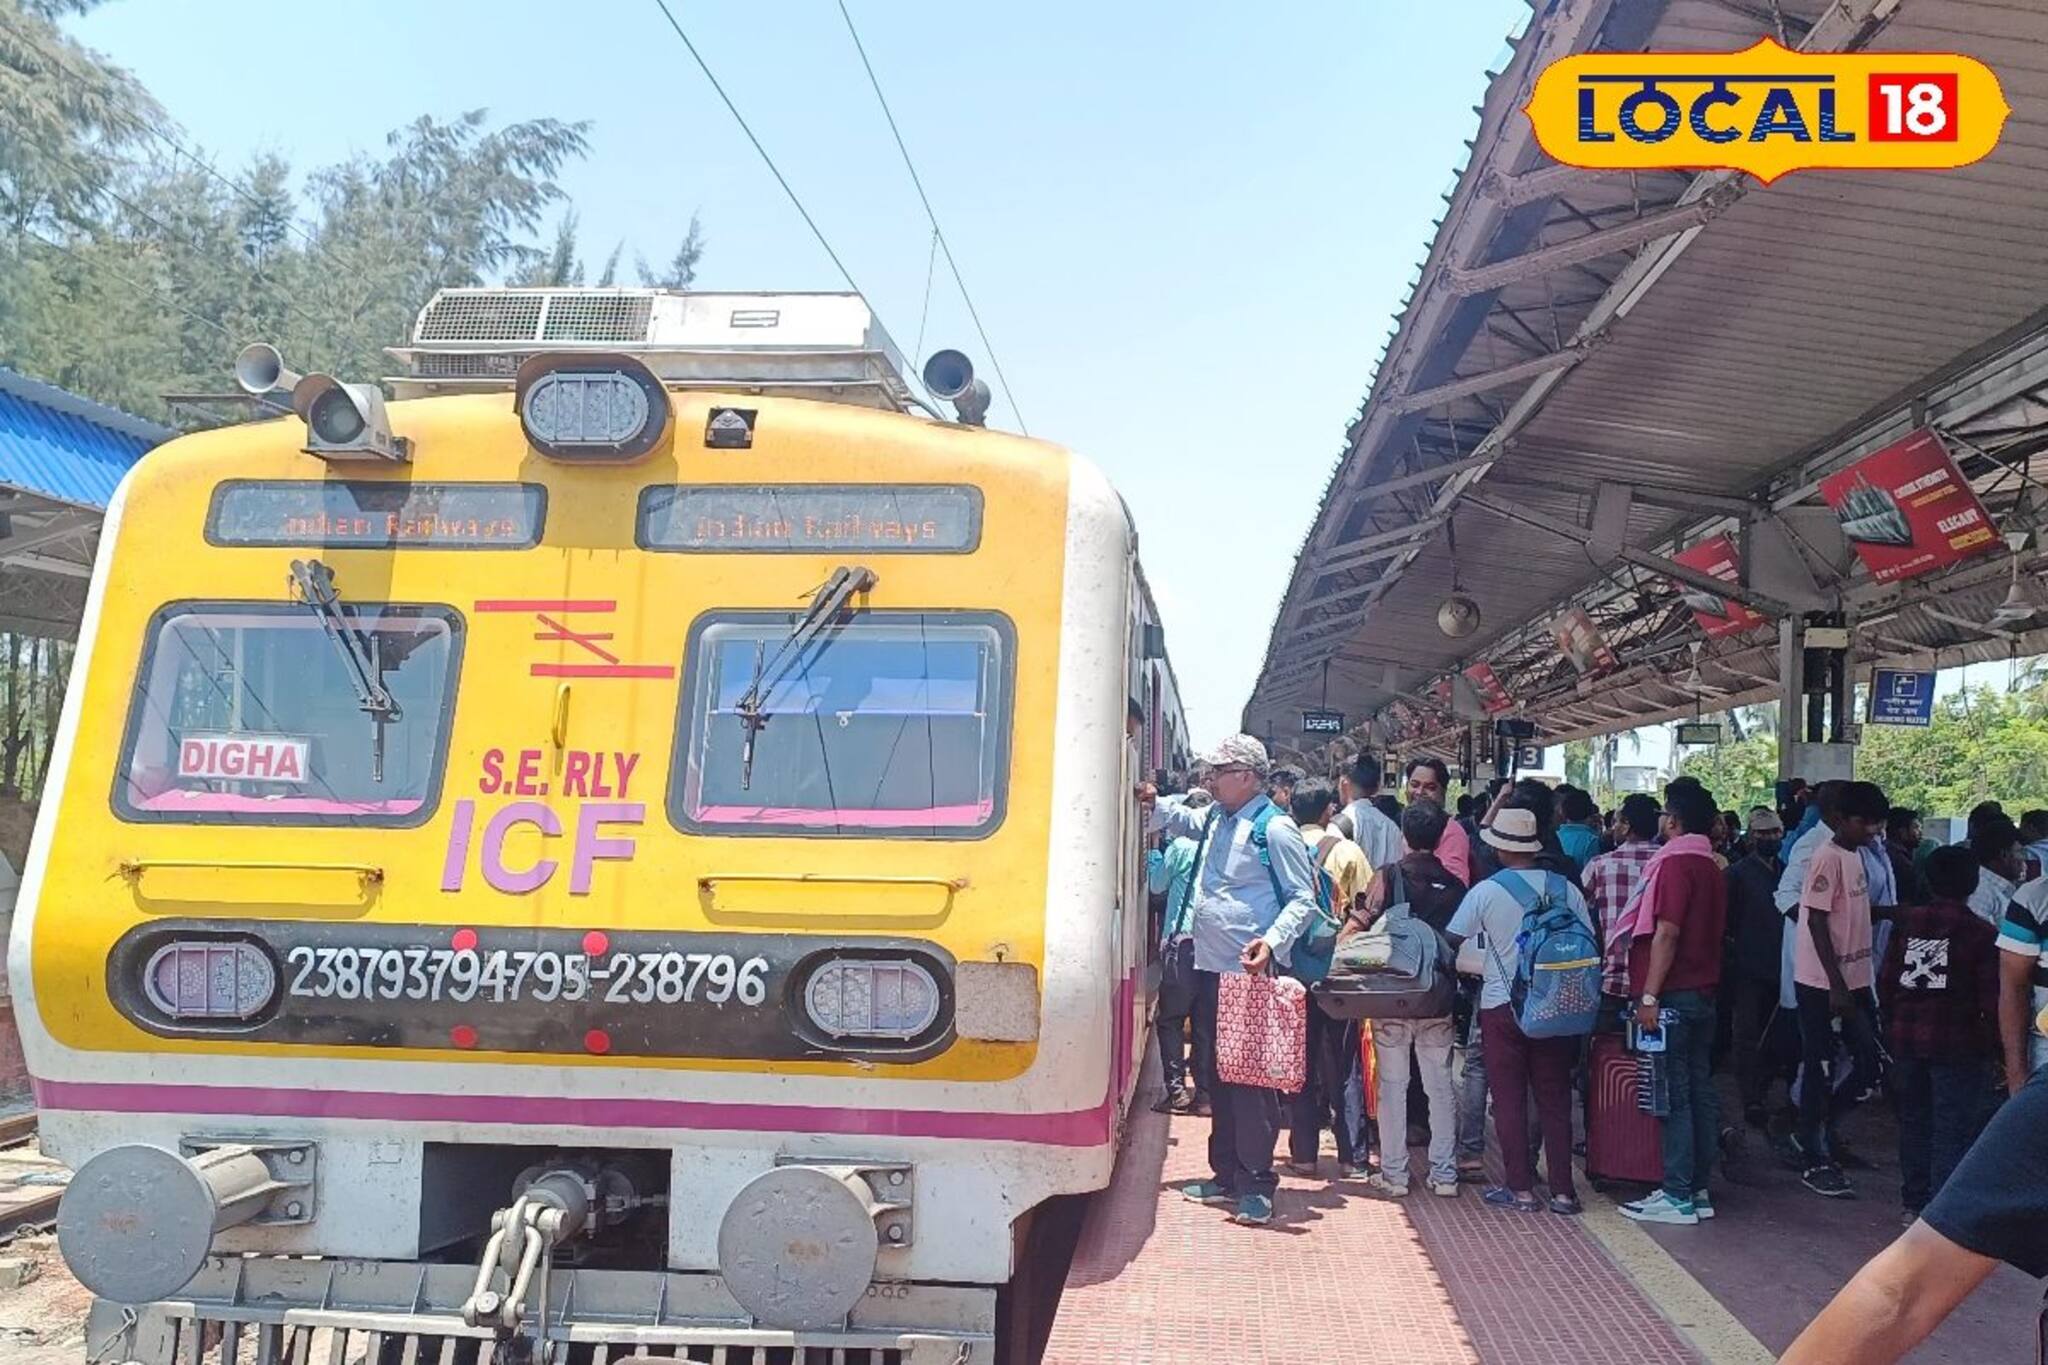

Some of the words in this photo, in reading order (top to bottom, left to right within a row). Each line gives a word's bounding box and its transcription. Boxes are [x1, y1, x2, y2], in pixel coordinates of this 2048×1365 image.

[285, 512, 372, 537] ndian
[182, 741, 300, 778] DIGHA
[479, 748, 548, 796] S.E.
[562, 750, 640, 799] RLY
[1523, 746, 1537, 765] 3
[441, 799, 646, 897] ICF
